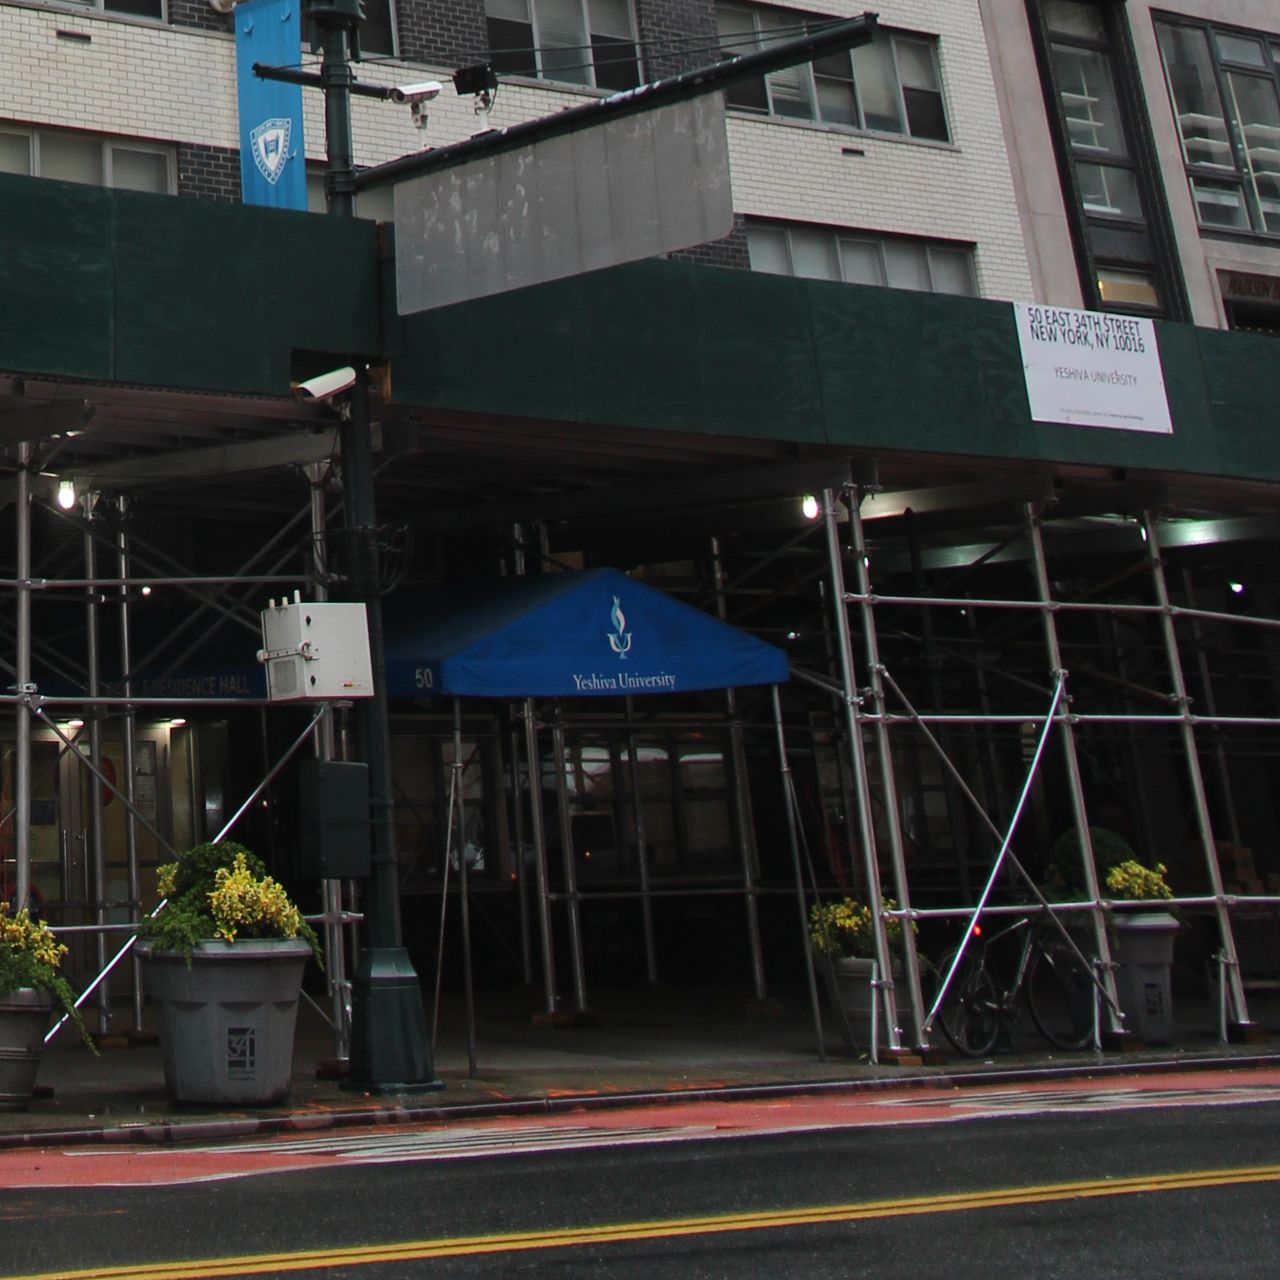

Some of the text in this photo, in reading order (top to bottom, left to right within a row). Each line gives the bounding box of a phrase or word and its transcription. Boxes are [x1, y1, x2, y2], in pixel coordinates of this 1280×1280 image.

[1027, 307, 1140, 337] 50 EAST 34TH STREET
[1030, 325, 1145, 353] NEW YORK, NY 10016
[1053, 365, 1138, 387] YESHIVA UNIVERSITY
[219, 674, 250, 694] HALL
[415, 668, 433, 689] 50
[572, 671, 676, 691] Yeshiva University
